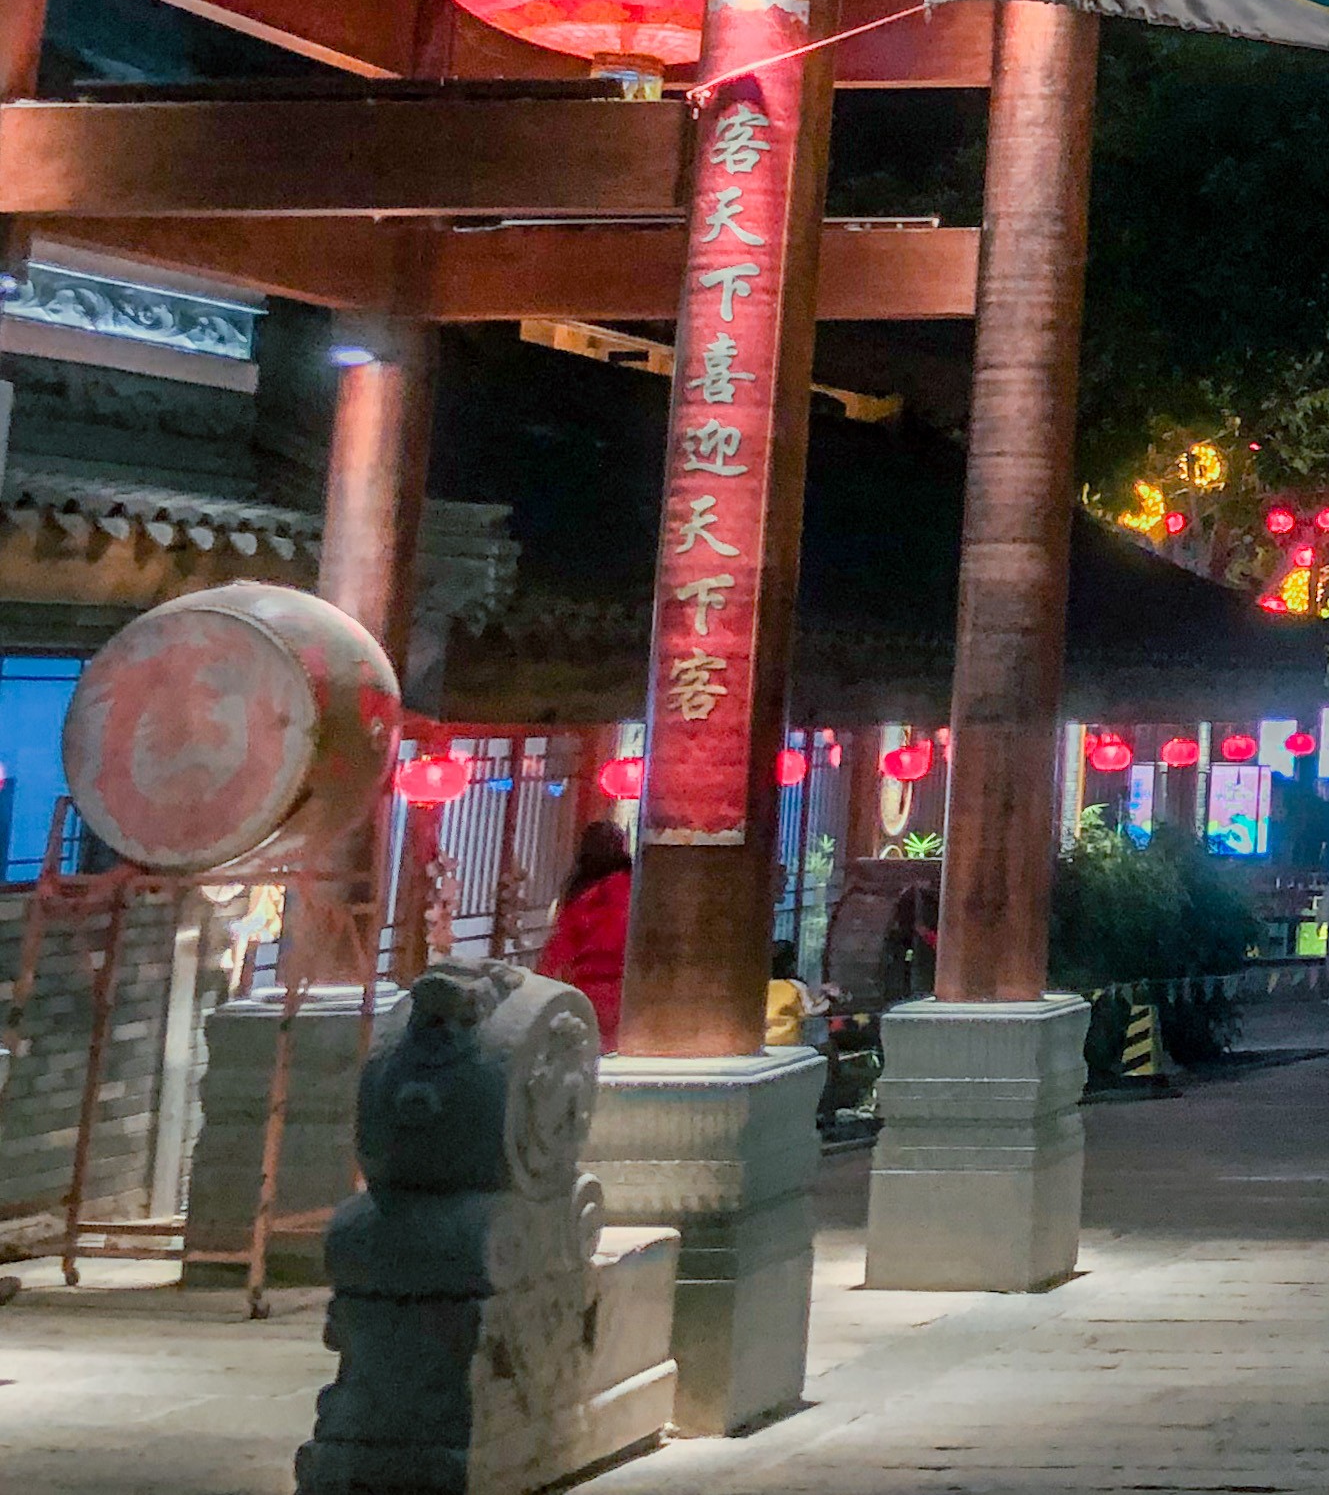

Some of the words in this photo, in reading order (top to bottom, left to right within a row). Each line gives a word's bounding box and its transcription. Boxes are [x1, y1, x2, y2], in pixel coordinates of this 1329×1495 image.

[667, 104, 772, 722] 客天下喜迎天下客
